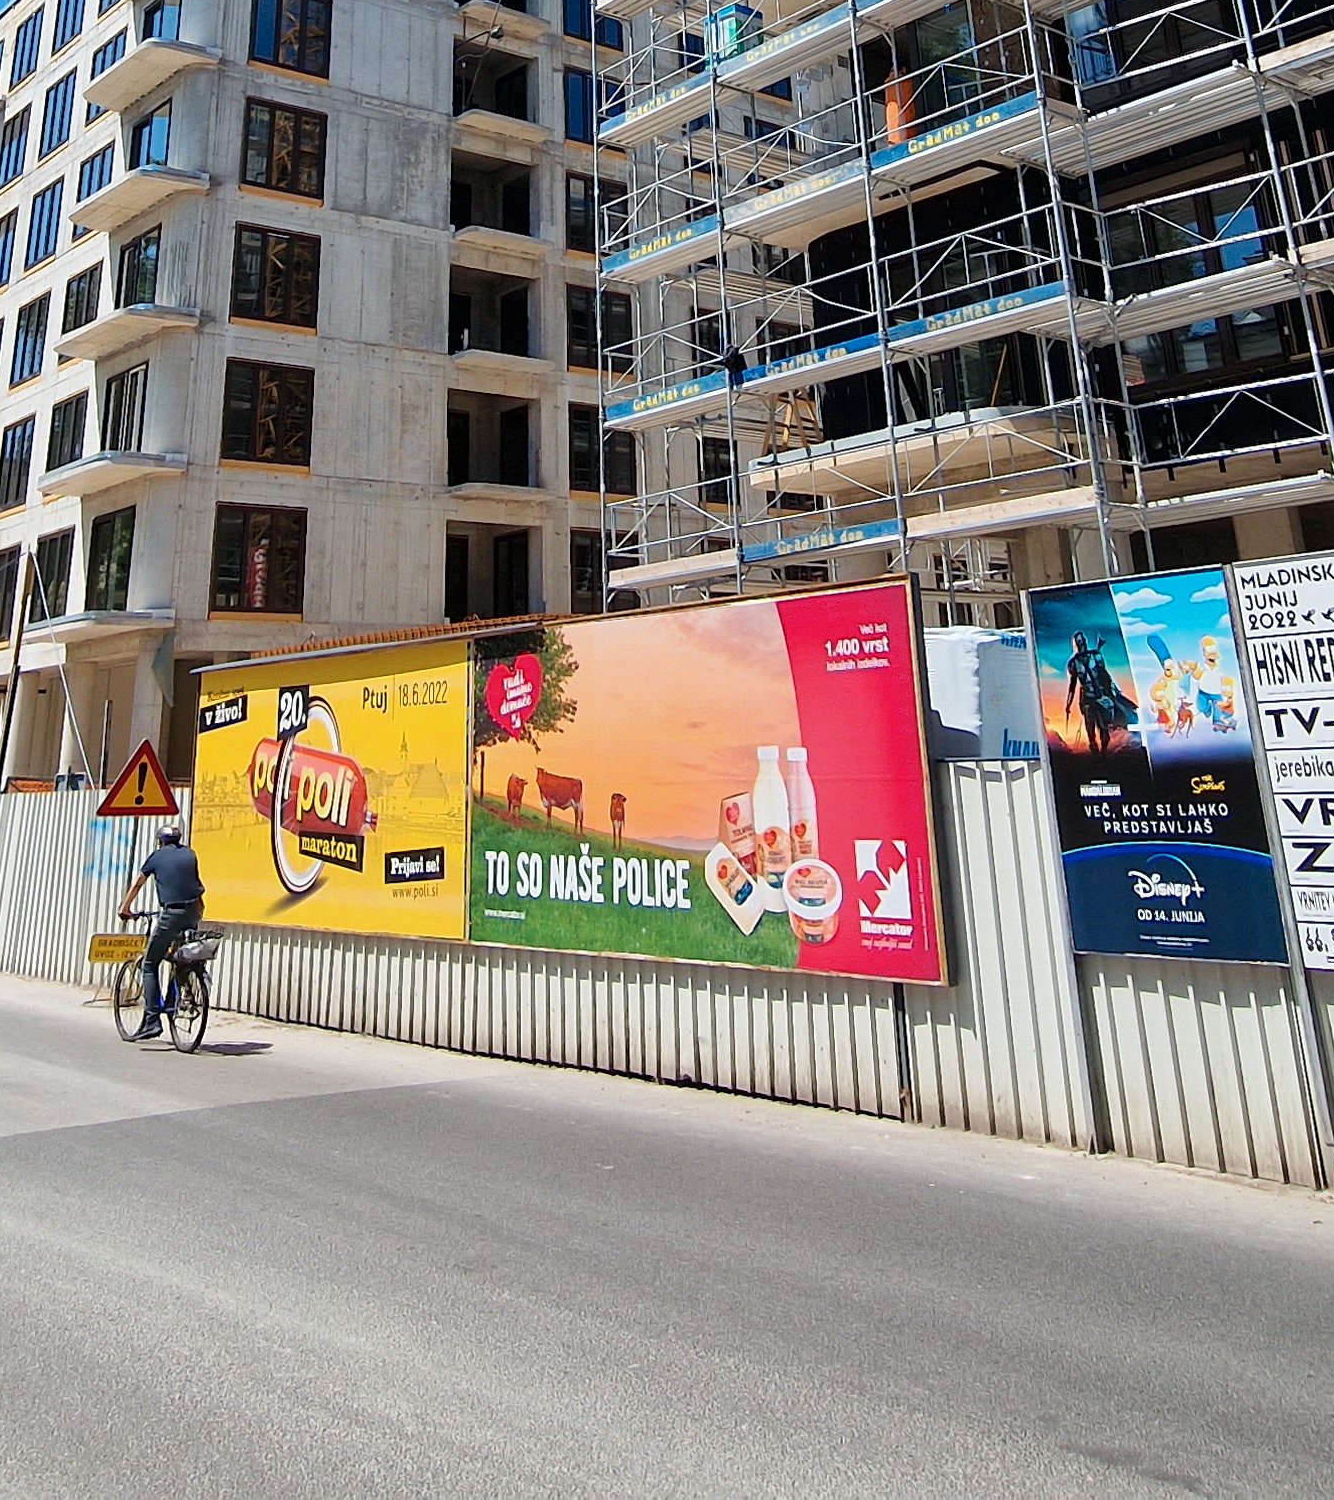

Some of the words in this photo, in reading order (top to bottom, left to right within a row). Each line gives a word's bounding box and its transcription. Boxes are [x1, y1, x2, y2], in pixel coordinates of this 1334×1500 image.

[908, 122, 969, 154] GradMat
[927, 303, 991, 330] GradMat
[778, 532, 835, 555] GradMat
[1245, 590, 1298, 611] JUNIJ
[1249, 610, 1297, 630] 2022
[825, 638, 860, 657] 1.400
[862, 636, 889, 653] vrst
[362, 685, 387, 714] Ptuj
[399, 680, 447, 706] 18.6.2022
[214, 699, 242, 723] živo!
[280, 691, 306, 732] 20.
[296, 765, 354, 827] poli
[1084, 803, 1116, 819] VEČ,
[1122, 804, 1149, 817] KOT
[1156, 804, 1172, 816] SI
[1178, 803, 1228, 817] LAHKO
[1104, 818, 1213, 834] PREDSTAVLJAŠ
[301, 836, 357, 863] maraton
[391, 855, 423, 878] Prijavi
[426, 854, 439, 873] se!
[485, 851, 509, 895] TO
[517, 852, 543, 898] SO
[550, 843, 605, 903] NAŠE
[613, 856, 691, 909] POLICE
[393, 883, 438, 901] www.poli.si
[860, 920, 913, 936] Mercator
[1138, 909, 1153, 920] OD
[1154, 910, 1169, 922] 14.
[1171, 910, 1205, 923] JUNIJA
[1305, 928, 1328, 952] 66.
